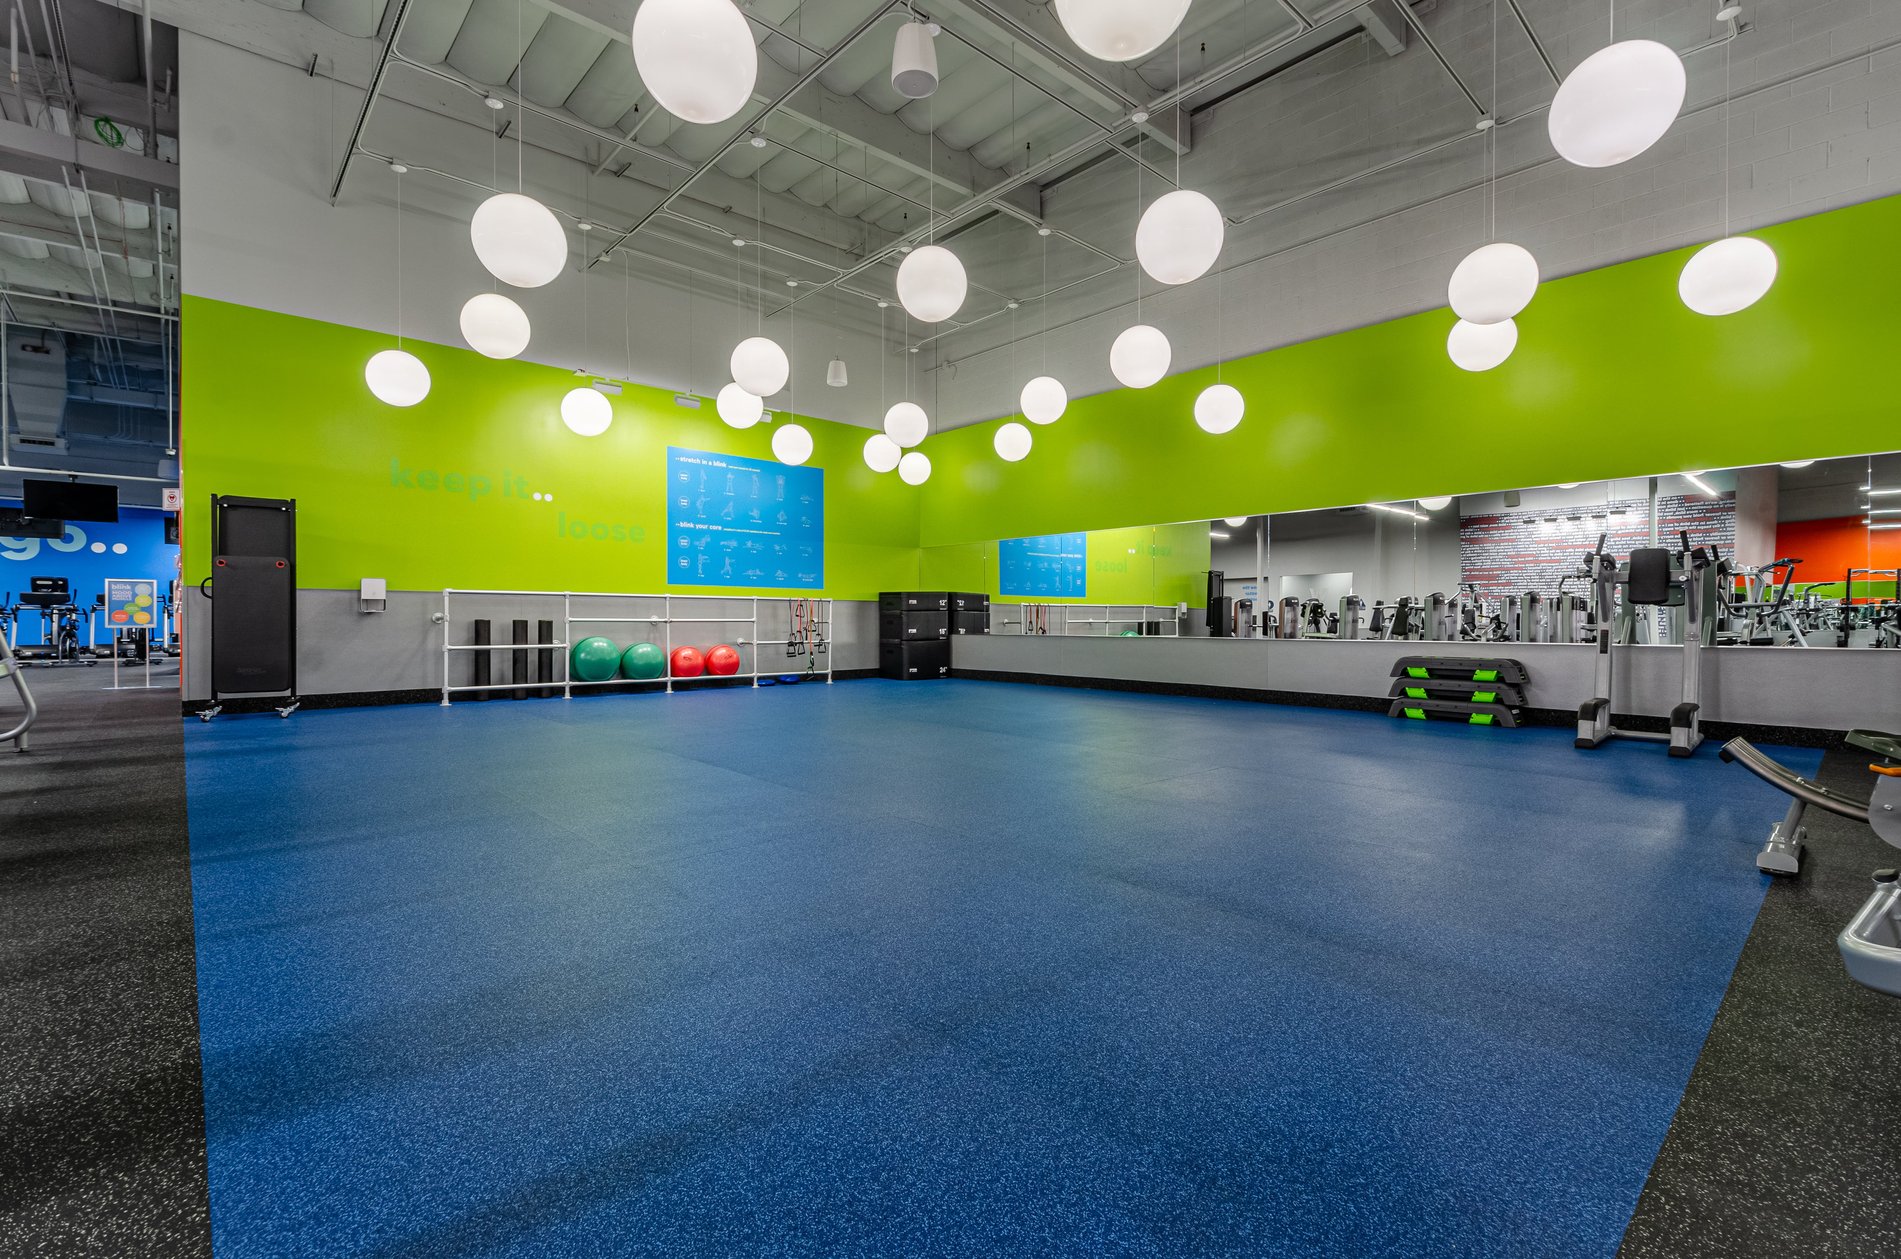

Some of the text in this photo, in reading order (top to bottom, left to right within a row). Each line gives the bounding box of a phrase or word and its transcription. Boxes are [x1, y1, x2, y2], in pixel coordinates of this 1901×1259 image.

[390, 456, 492, 502] keep
[713, 460, 727, 468] blink
[558, 511, 645, 543] loose
